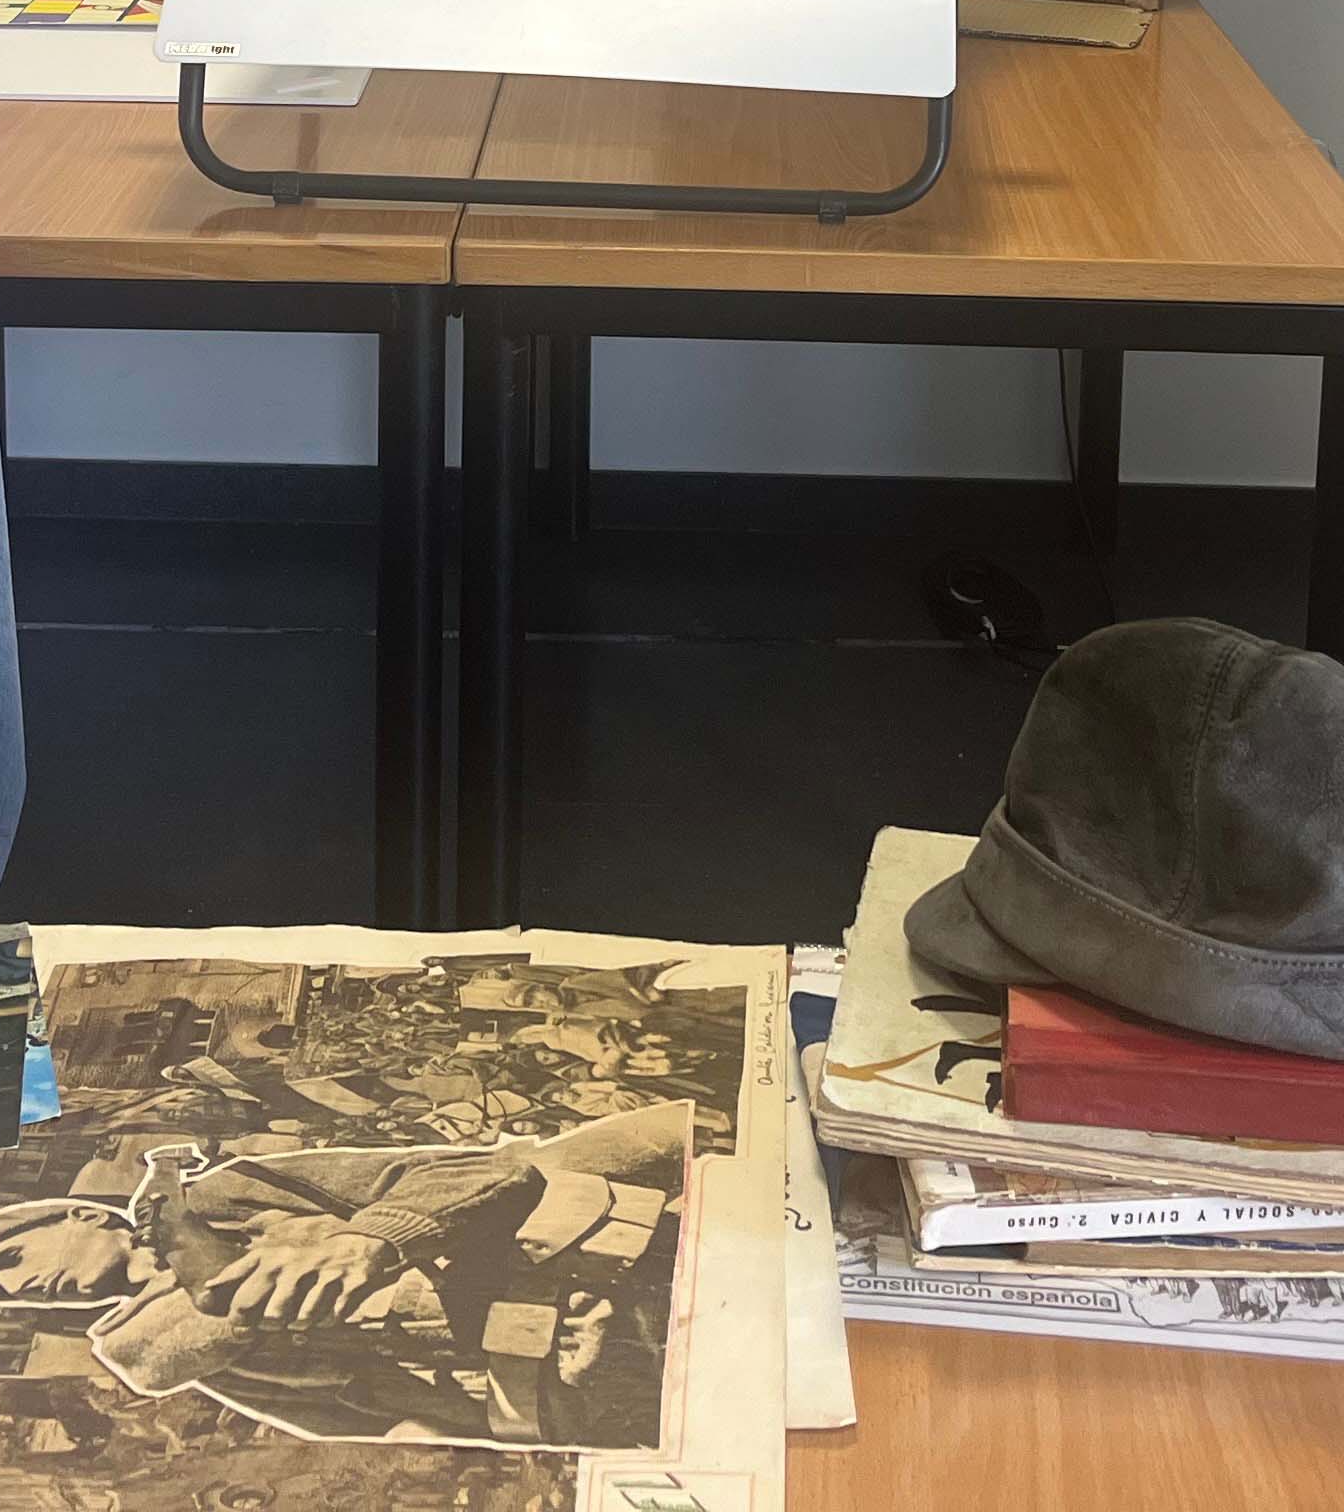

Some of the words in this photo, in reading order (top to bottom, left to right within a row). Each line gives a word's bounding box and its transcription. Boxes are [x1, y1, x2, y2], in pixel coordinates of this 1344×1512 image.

[1007, 1215, 1059, 1228] Curso
[1110, 1211, 1179, 1225] CIVICA
[1197, 1210, 1207, 1222] Y
[840, 1275, 992, 1299] Constitución
[1001, 1287, 1113, 1310] española
